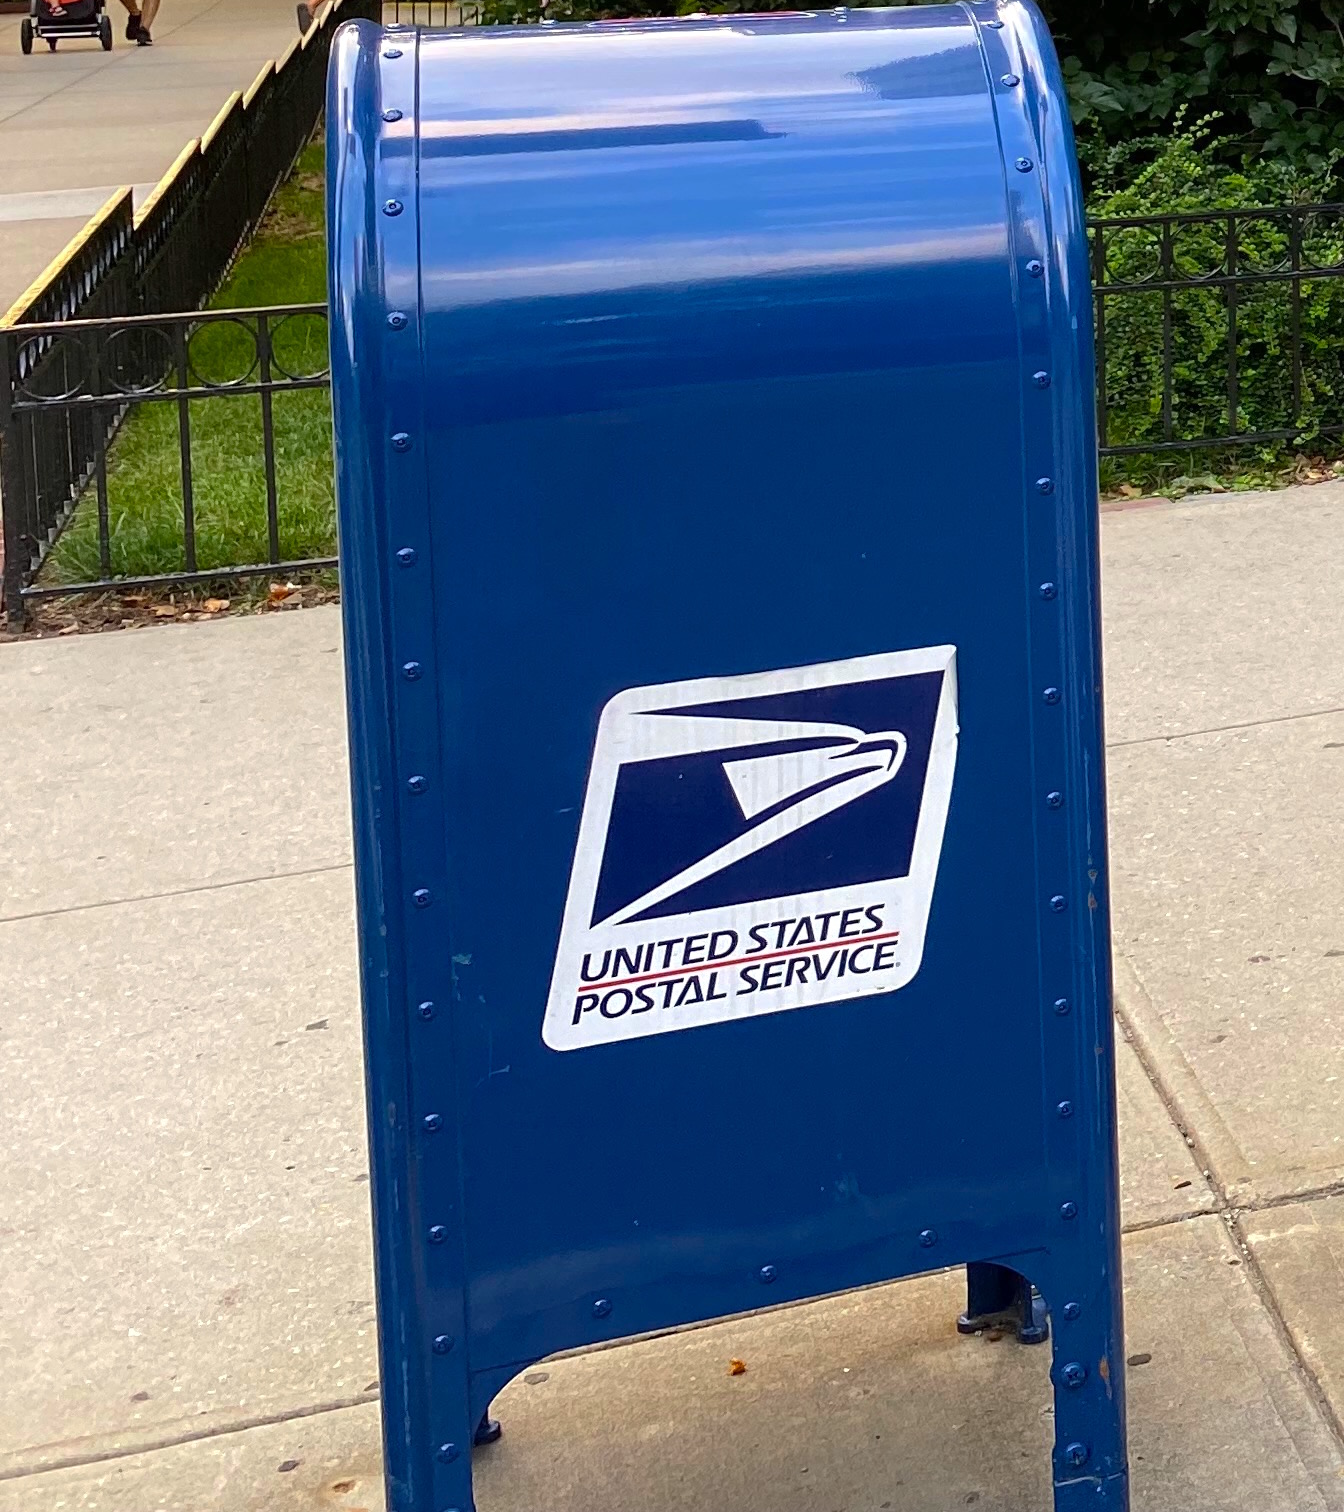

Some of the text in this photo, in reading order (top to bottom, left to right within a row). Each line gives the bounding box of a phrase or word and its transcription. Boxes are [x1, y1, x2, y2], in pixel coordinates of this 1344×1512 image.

[580, 903, 885, 982] UNITED STATES
[571, 972, 727, 1025] POSTAL
